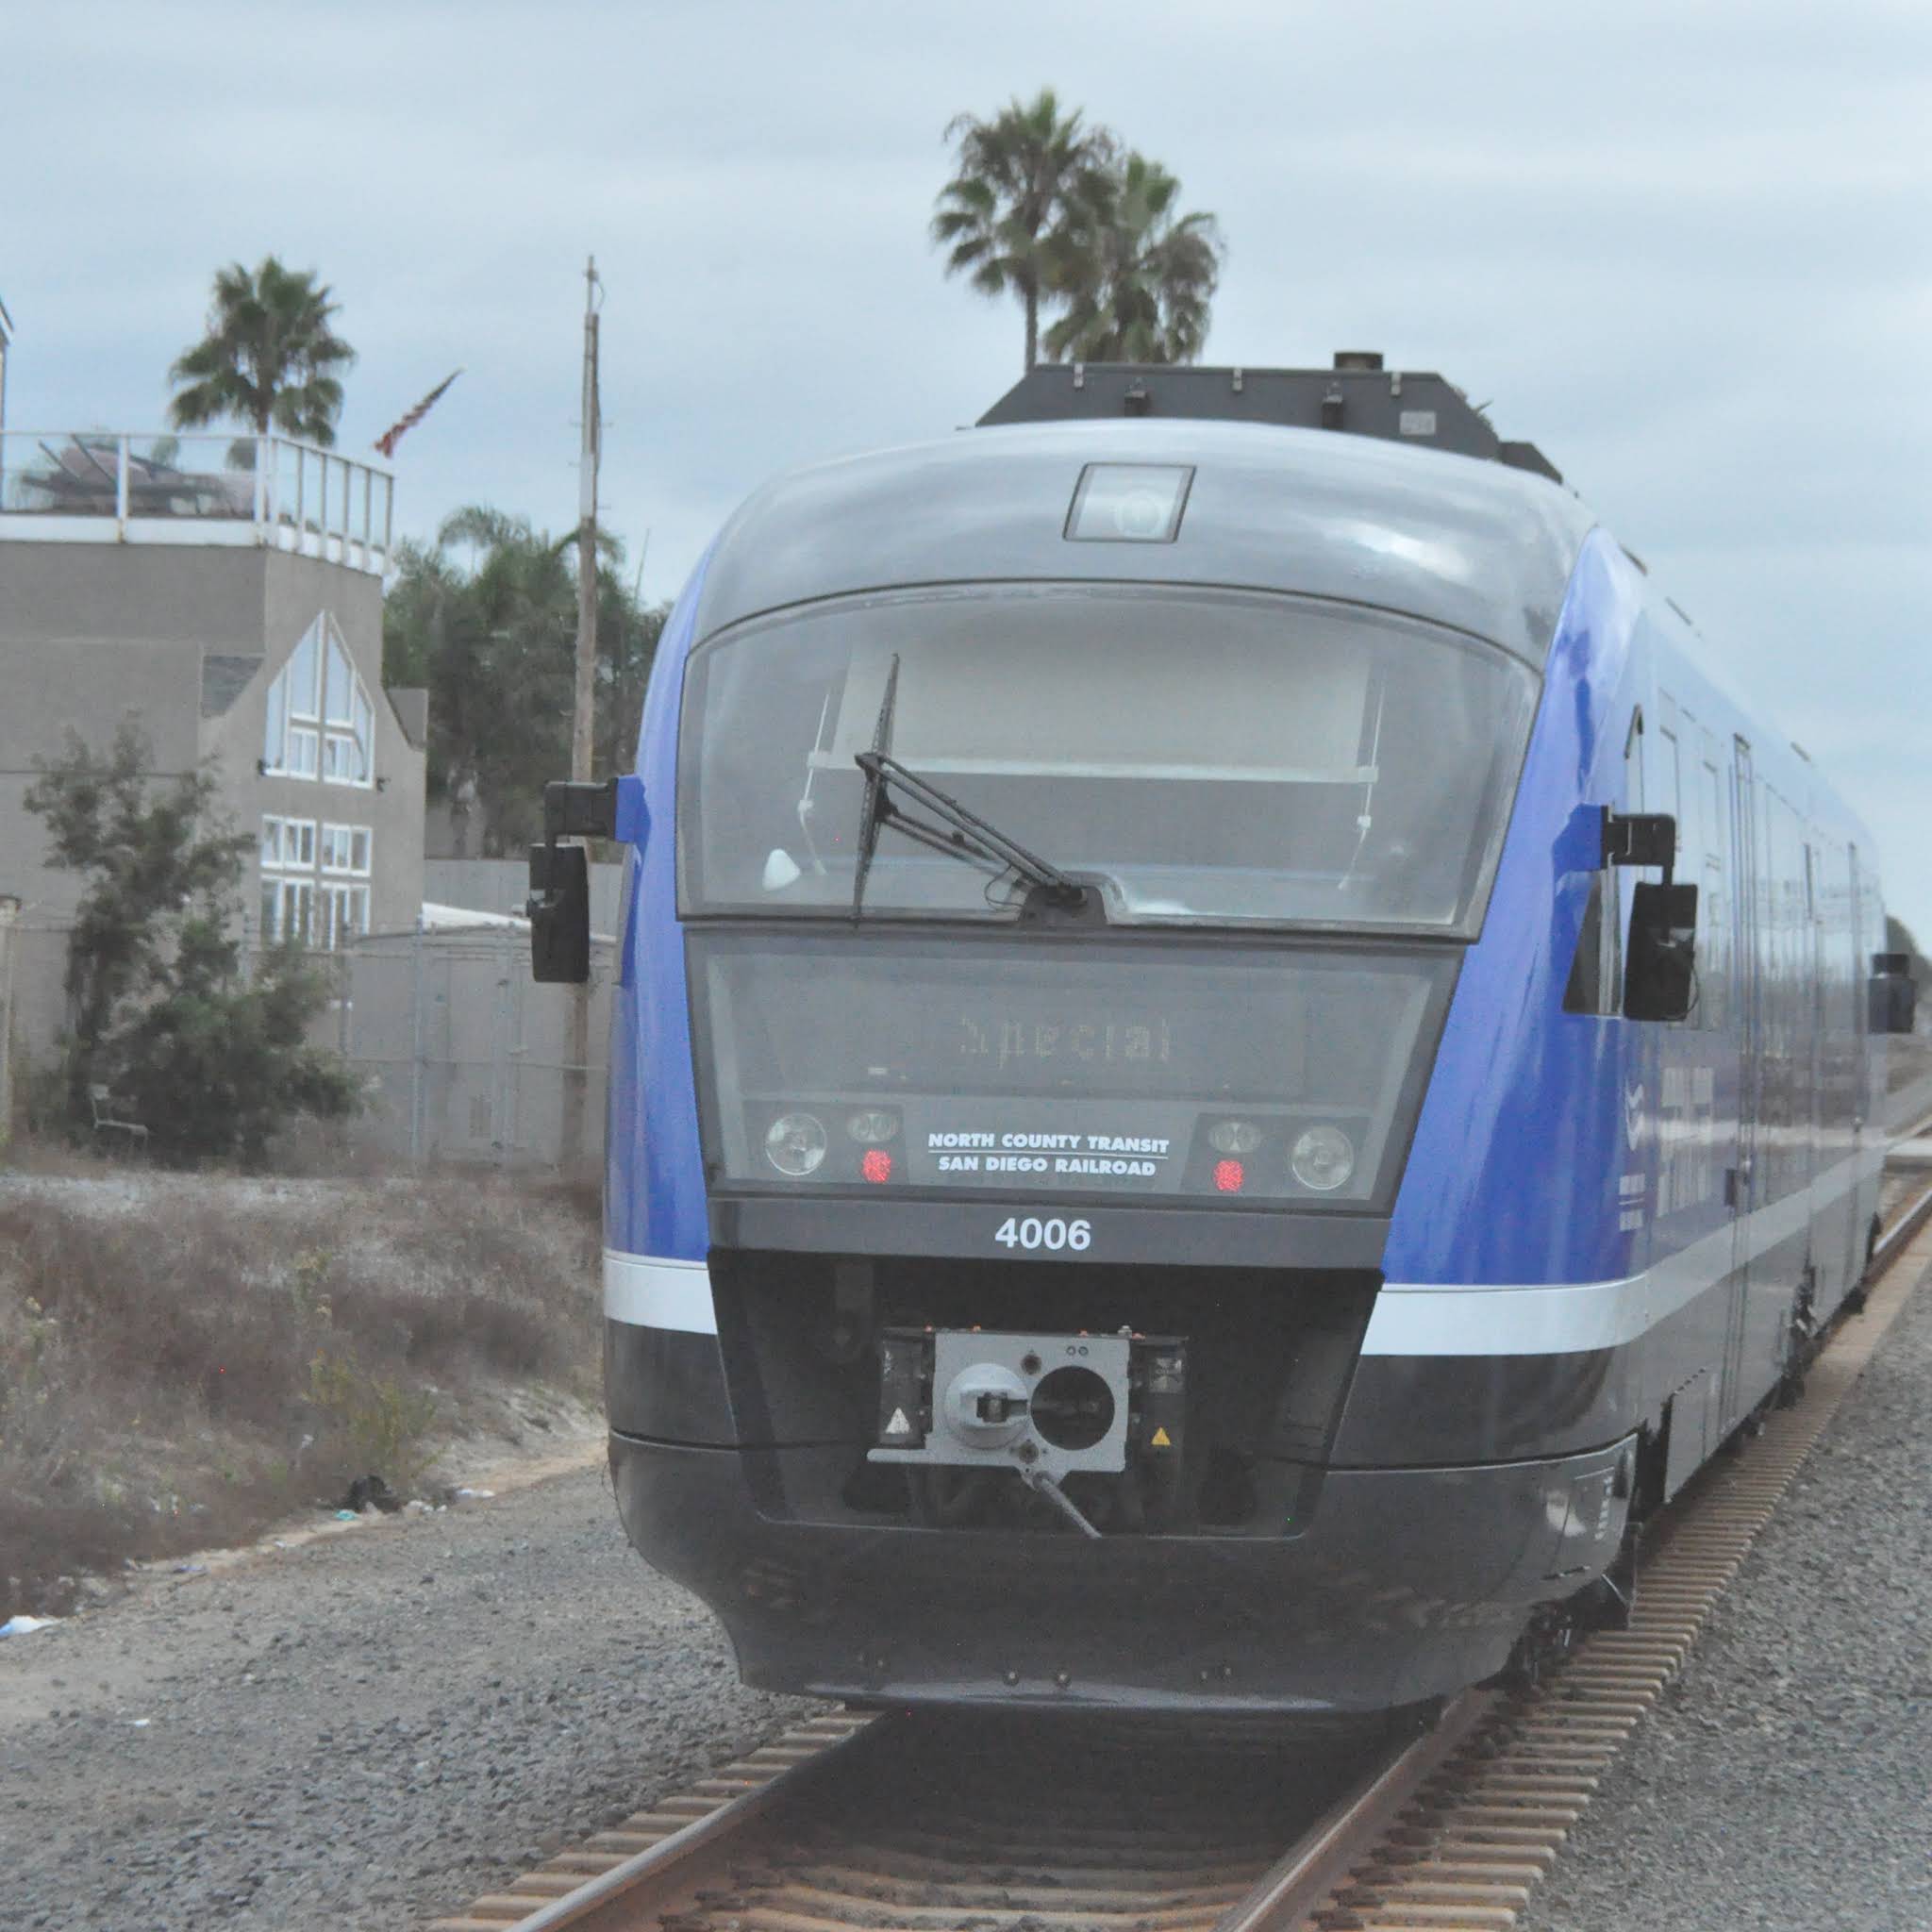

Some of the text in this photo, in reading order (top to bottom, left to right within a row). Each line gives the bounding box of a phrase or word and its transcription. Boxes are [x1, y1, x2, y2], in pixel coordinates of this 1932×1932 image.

[928, 1133, 1170, 1153] NORTH COUNTY TRANSIT
[939, 1157, 1157, 1176] SAN DIEGO RAILROAD
[995, 1218, 1091, 1251] 4006
